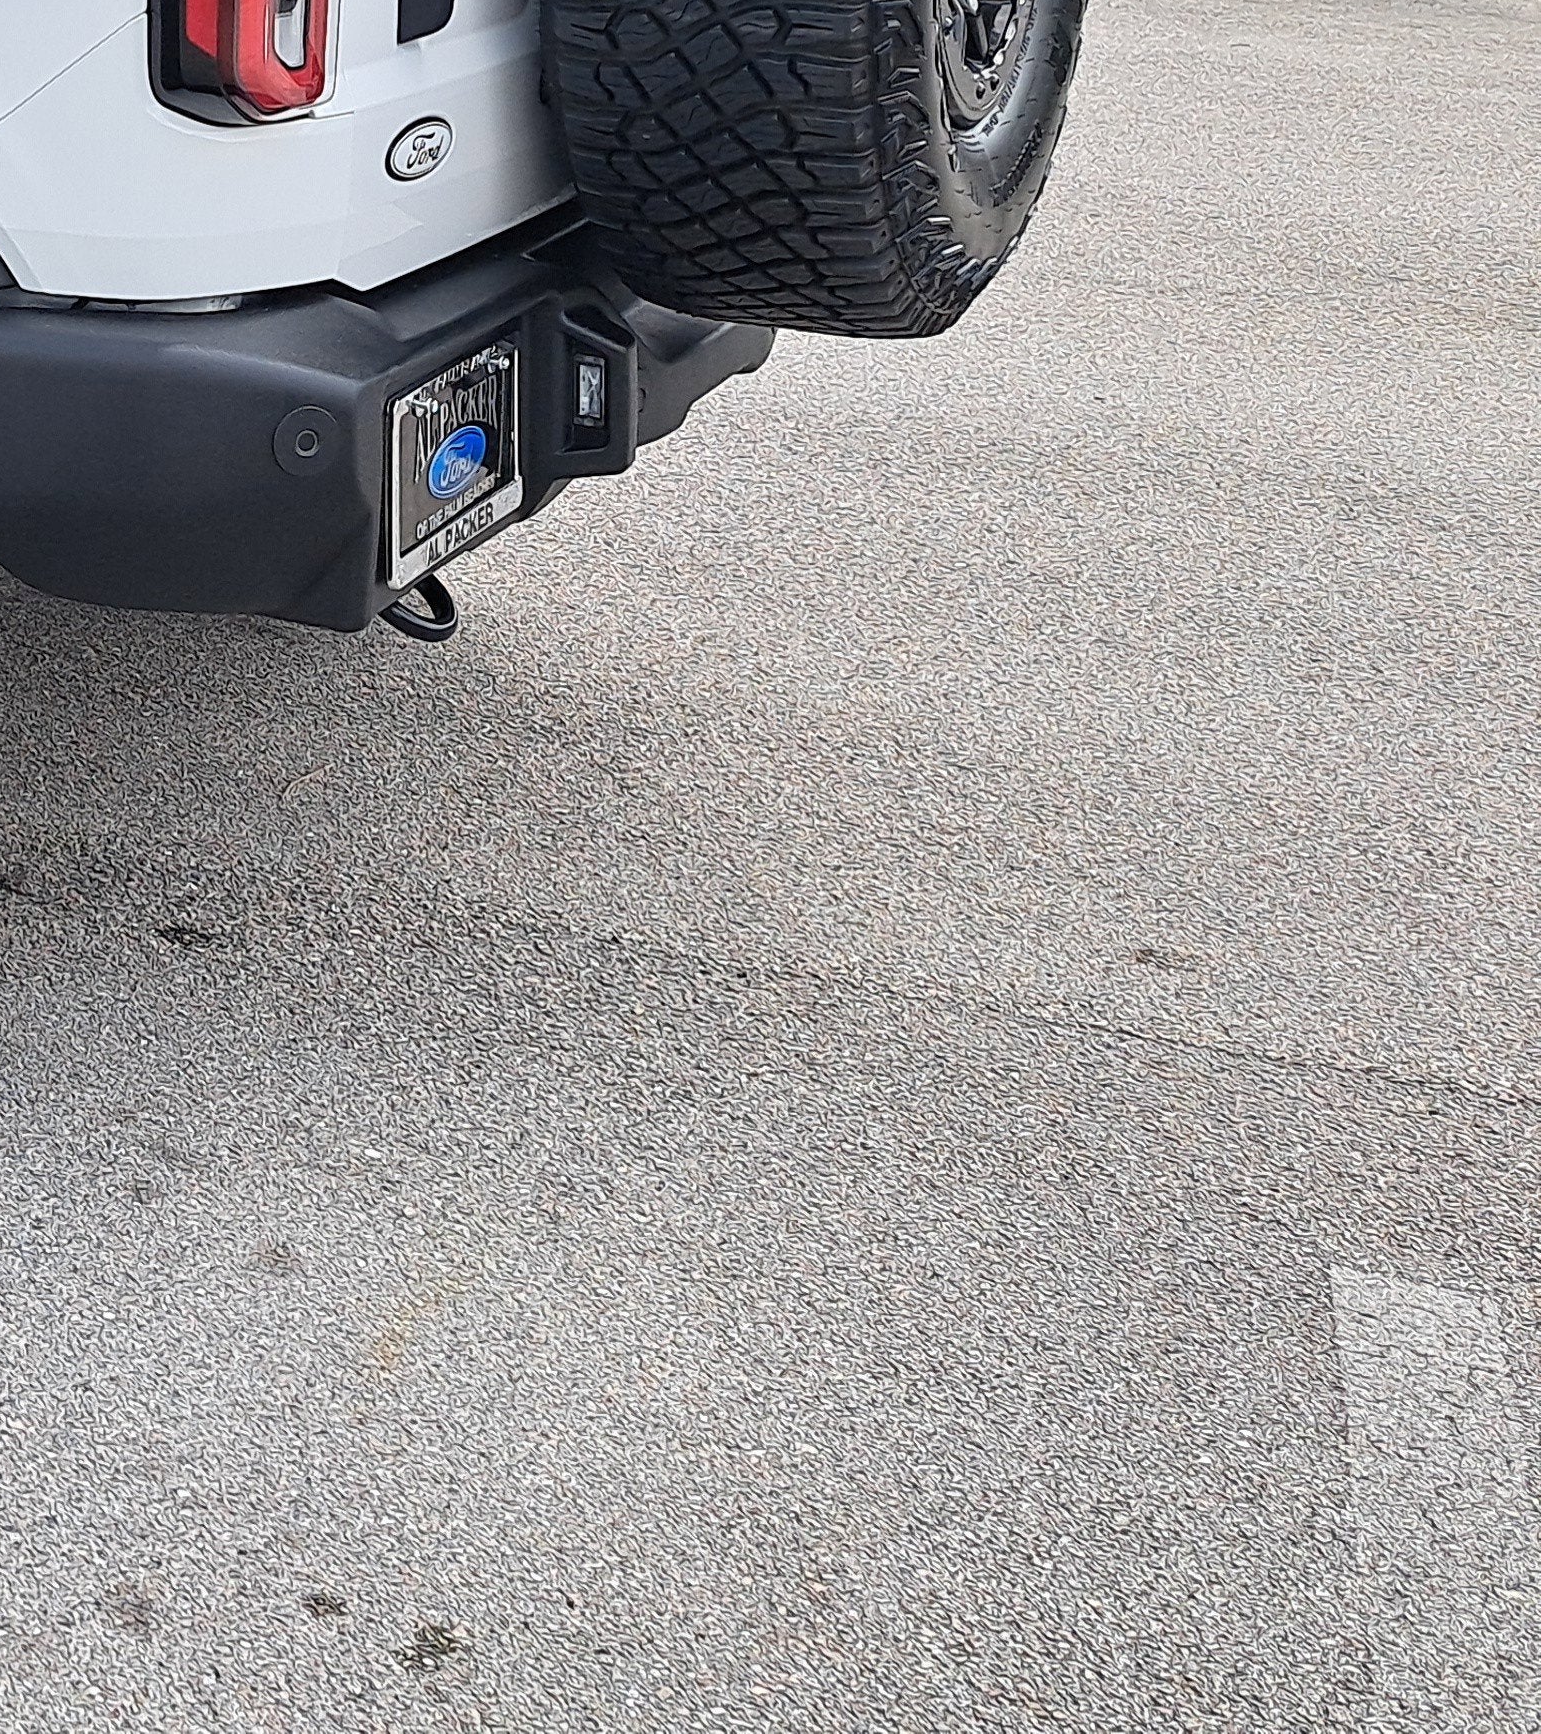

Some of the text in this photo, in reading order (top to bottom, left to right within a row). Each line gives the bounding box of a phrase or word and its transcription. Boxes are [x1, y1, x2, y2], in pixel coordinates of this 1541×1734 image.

[414, 374, 498, 484] AL PACKER
[427, 502, 493, 566] AL PACKER
